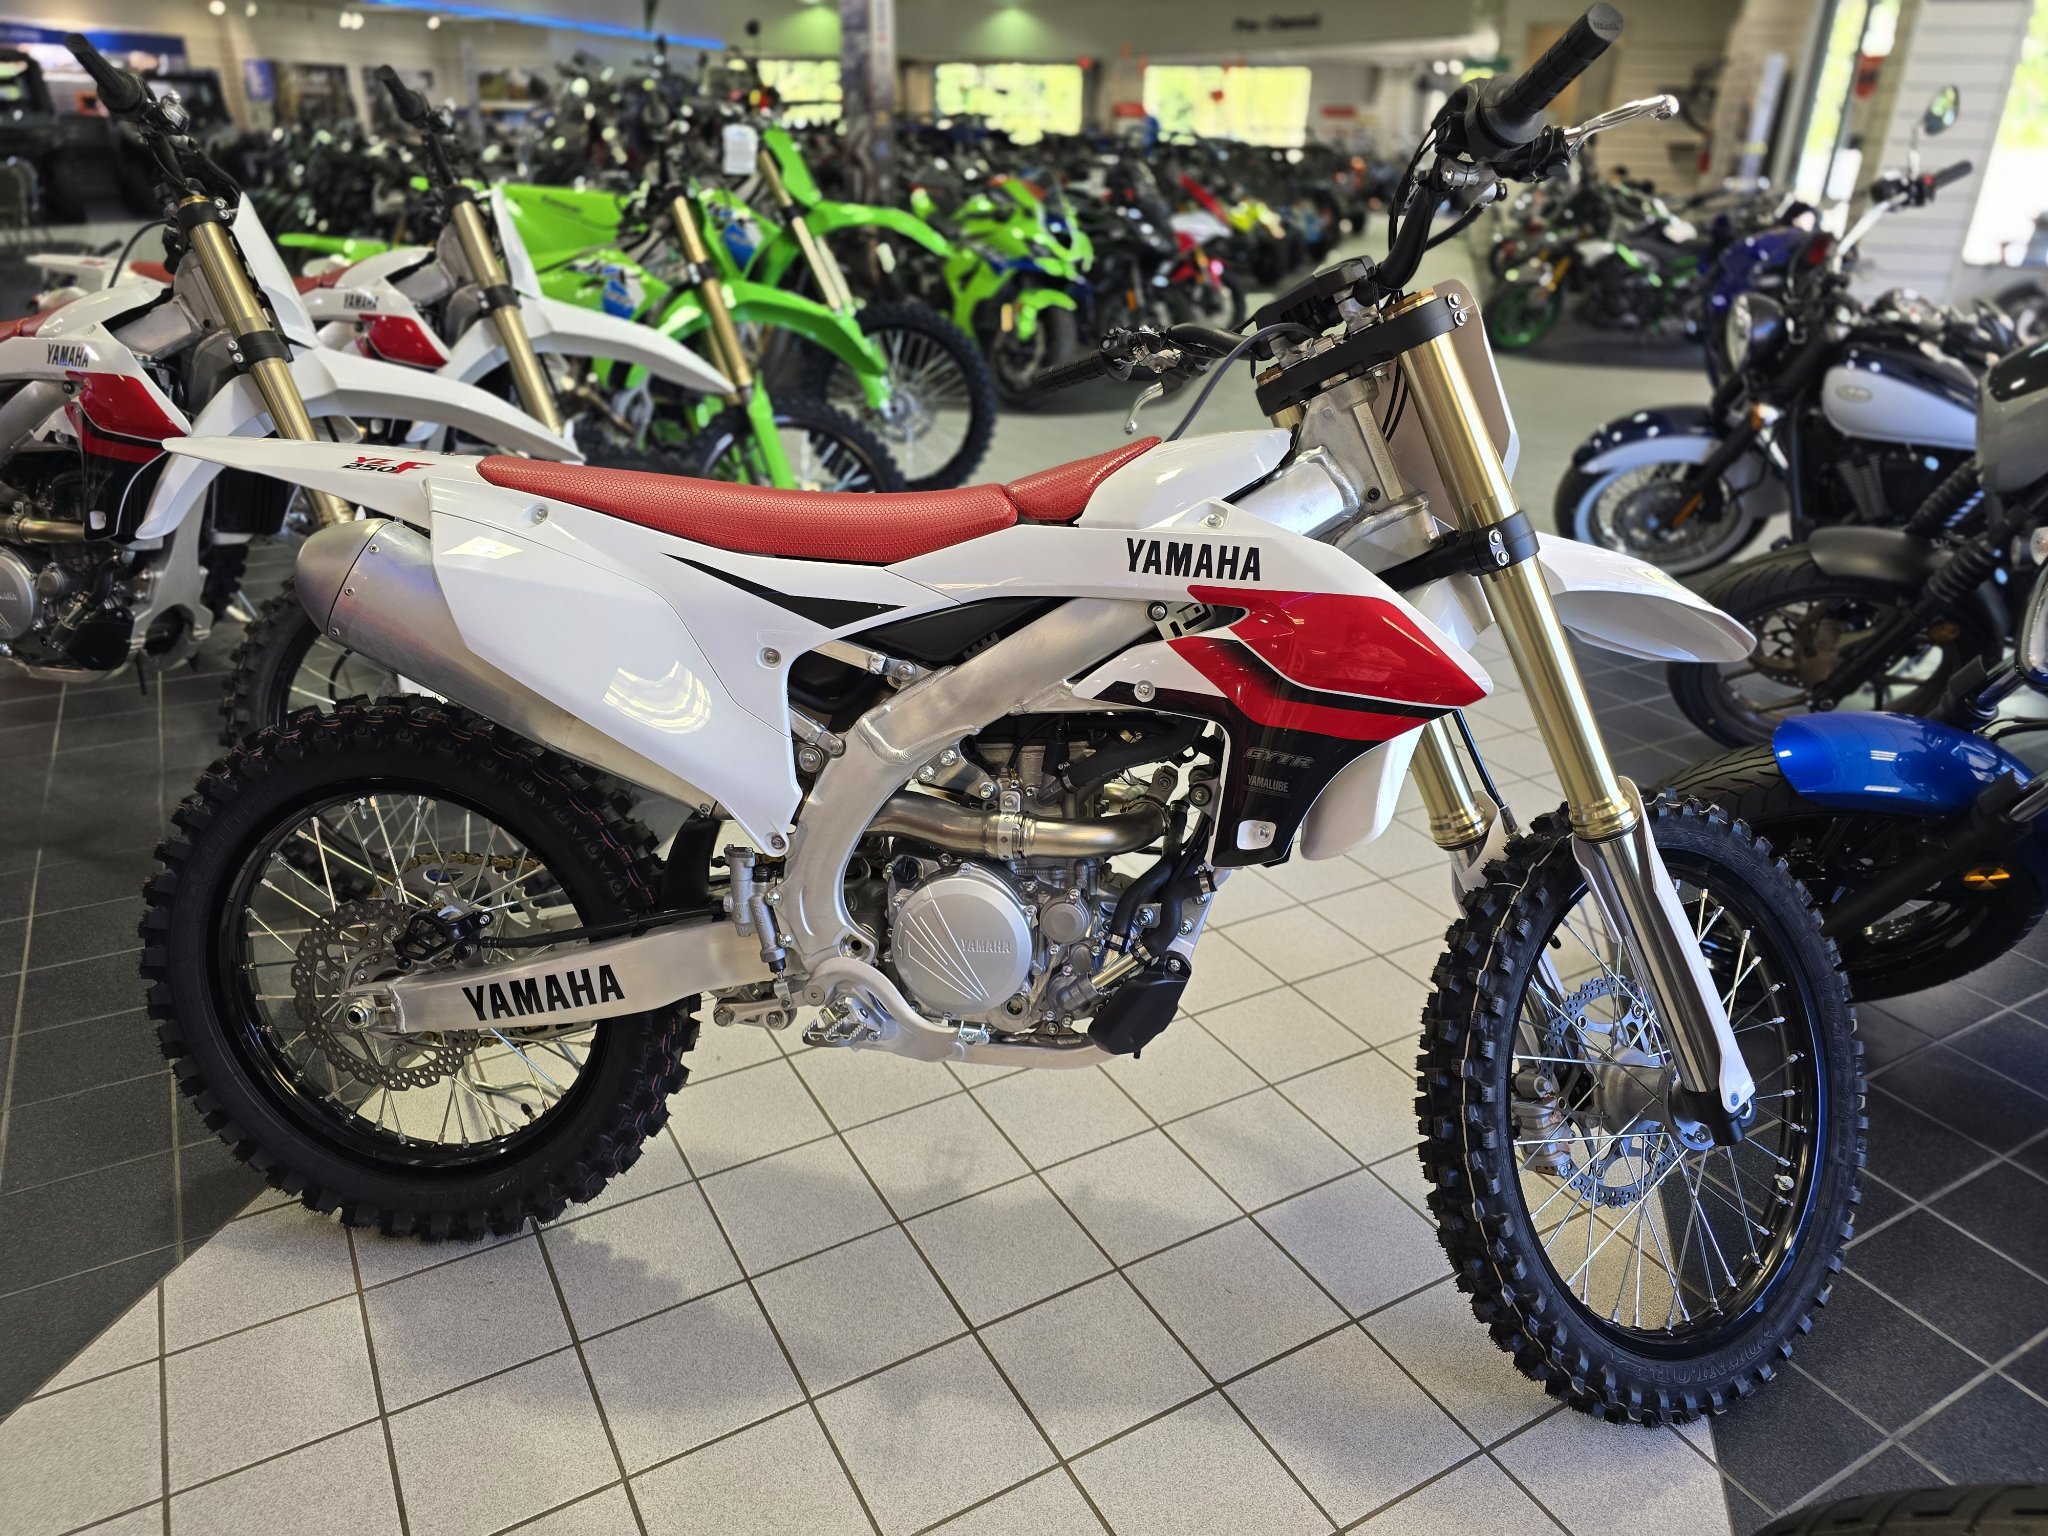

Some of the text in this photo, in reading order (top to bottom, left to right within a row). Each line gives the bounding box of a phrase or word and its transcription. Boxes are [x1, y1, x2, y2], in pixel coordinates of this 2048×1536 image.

[47, 343, 89, 368] YAMAHA
[1126, 537, 1261, 582] YAMAHA
[1243, 746, 1315, 769] GYTR
[1247, 774, 1289, 793] YAMALUBE
[960, 939, 1011, 954] YAMAHA
[461, 964, 626, 1022] YAMAHA
[1652, 1330, 1763, 1384] DUNLOP
